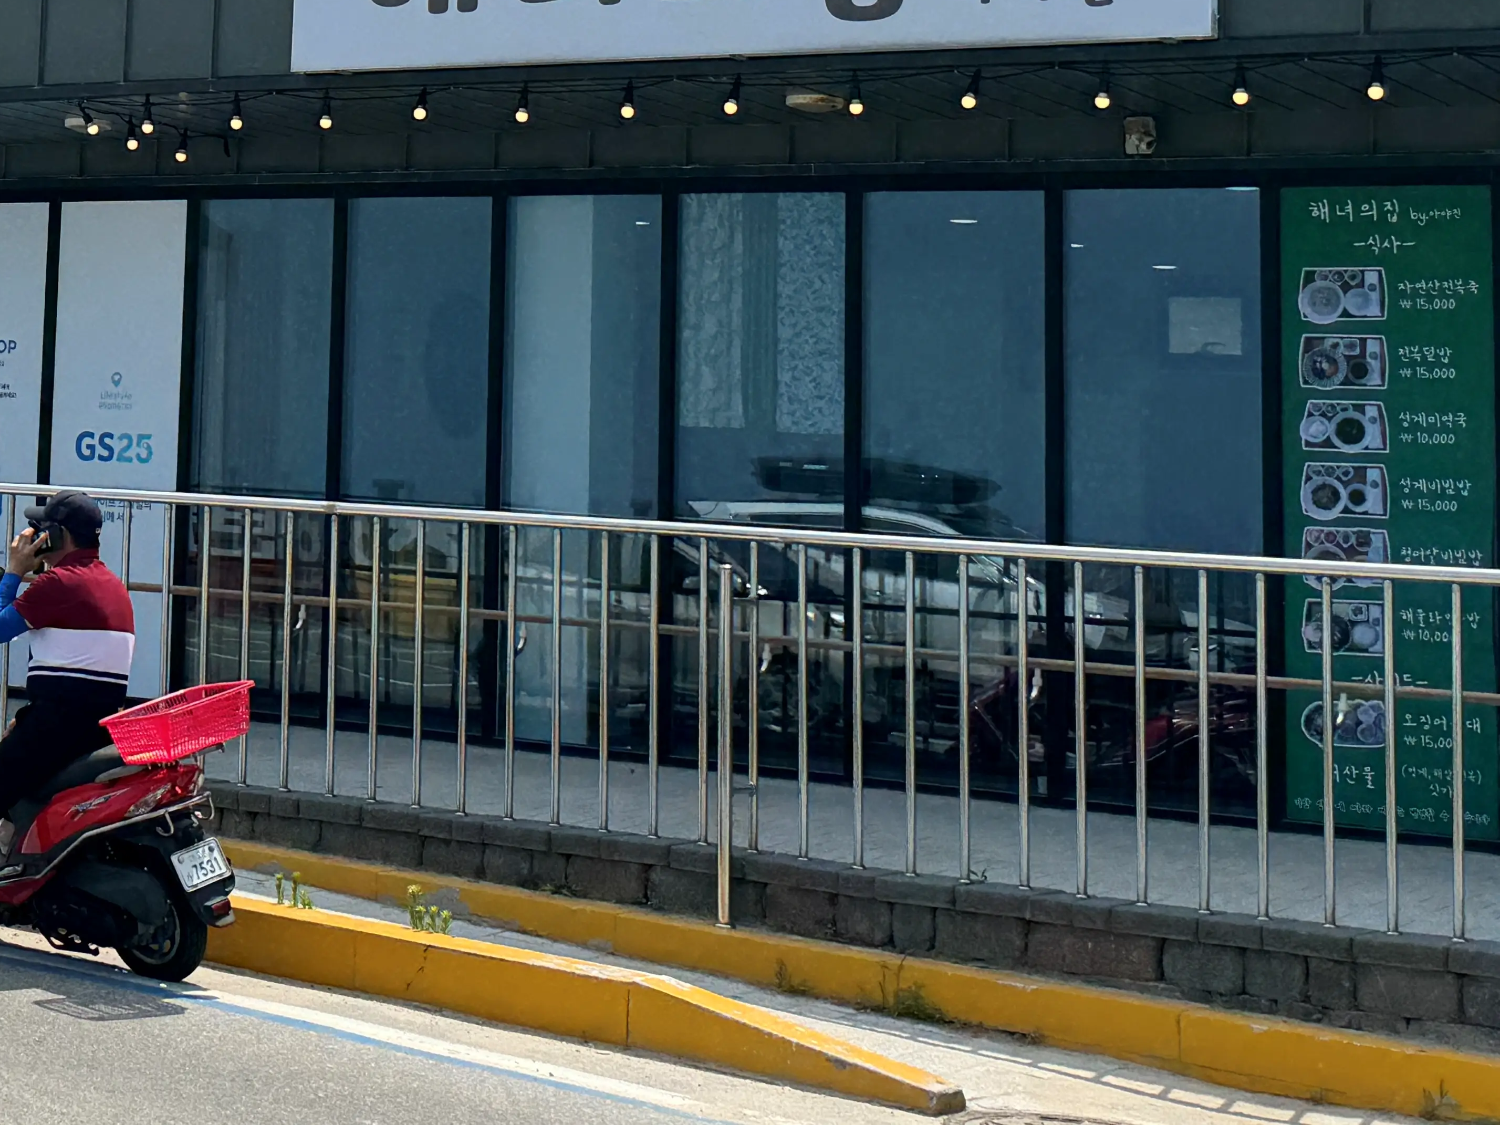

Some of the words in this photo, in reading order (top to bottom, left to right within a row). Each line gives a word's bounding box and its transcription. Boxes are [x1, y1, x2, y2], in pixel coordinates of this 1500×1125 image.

[1399, 411, 1467, 428] 성게미역국
[75, 430, 153, 464] GS25
[1400, 477, 1472, 496] 성게비빔밥
[1403, 714, 1481, 734] 오징어대
